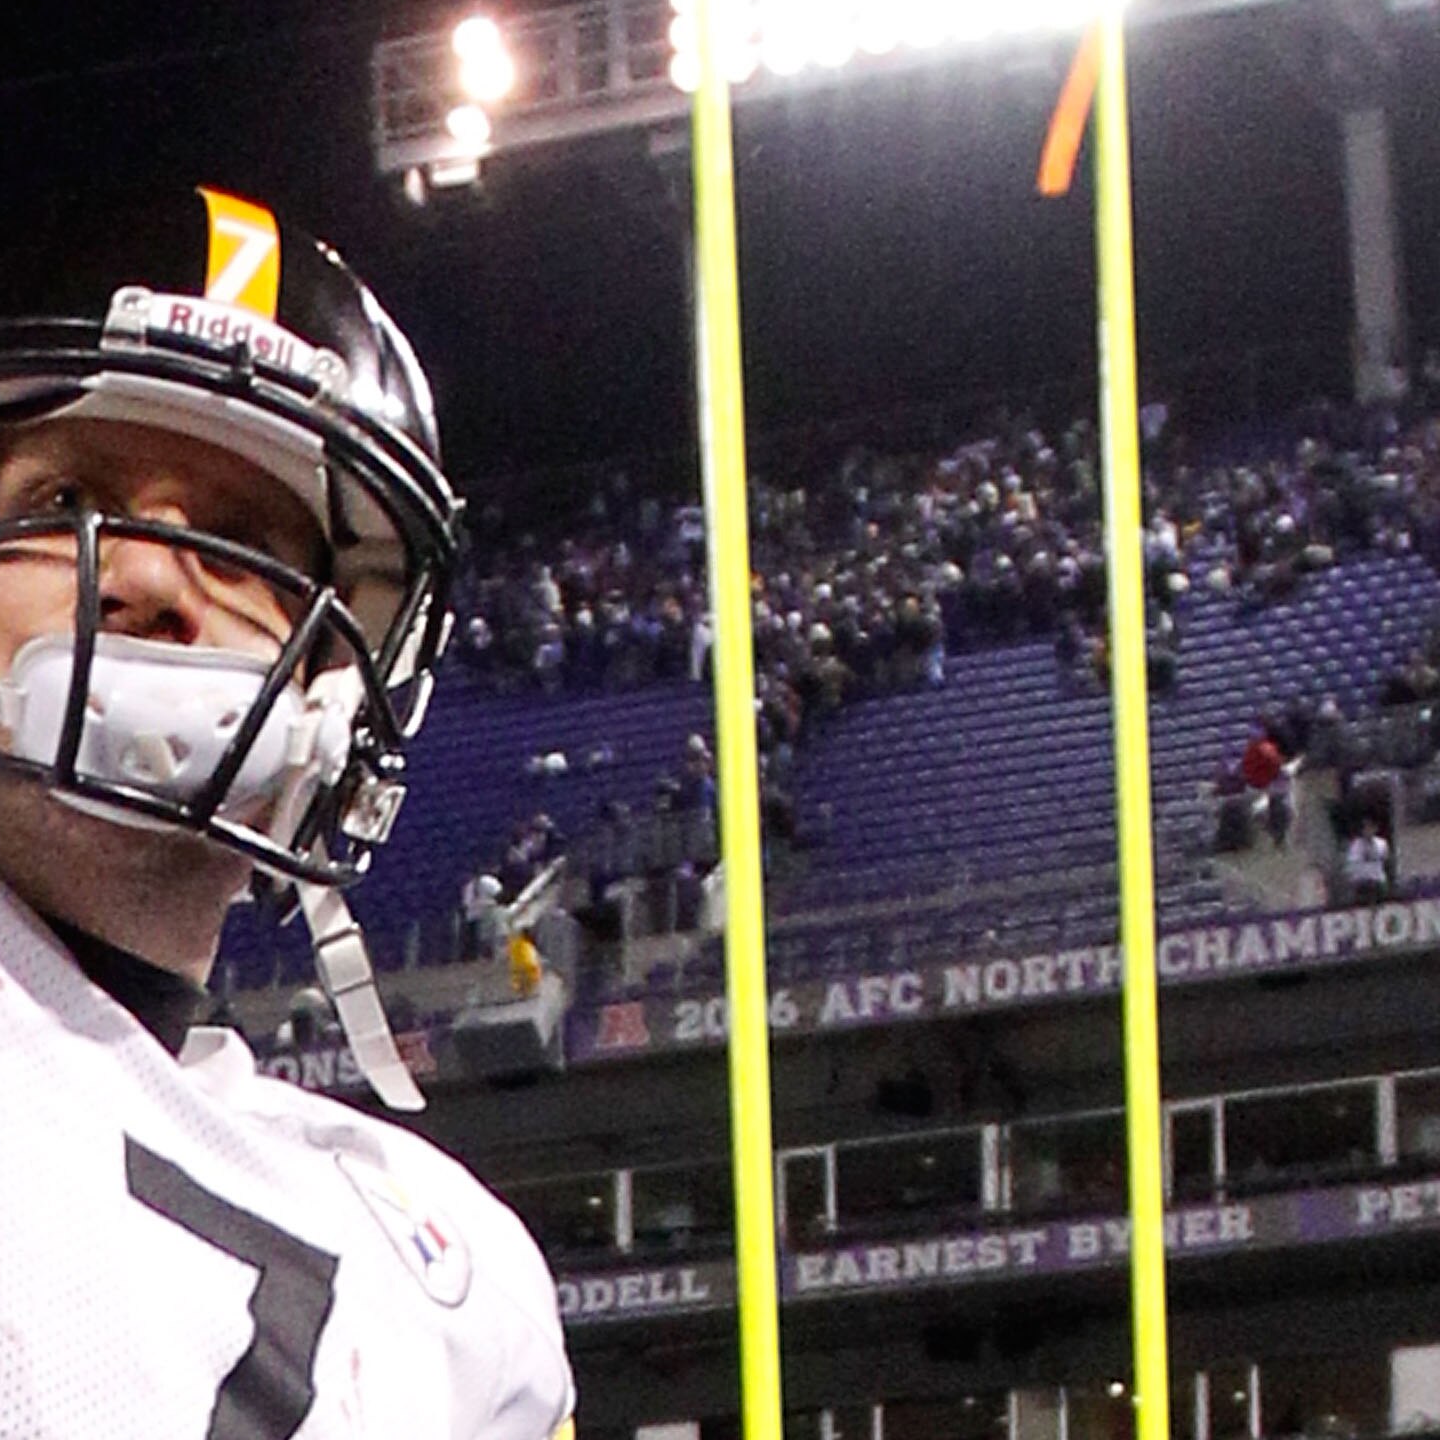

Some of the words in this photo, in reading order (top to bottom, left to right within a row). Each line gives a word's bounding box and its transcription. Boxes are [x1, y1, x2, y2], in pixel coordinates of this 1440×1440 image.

[204, 215, 278, 304] 7
[169, 302, 295, 373] Riddell
[672, 991, 799, 1040] 206
[819, 972, 923, 1025] AFC
[943, 944, 1123, 1007] NORTH
[257, 1047, 364, 1088] ONS
[796, 1231, 1047, 1290] EARNEST
